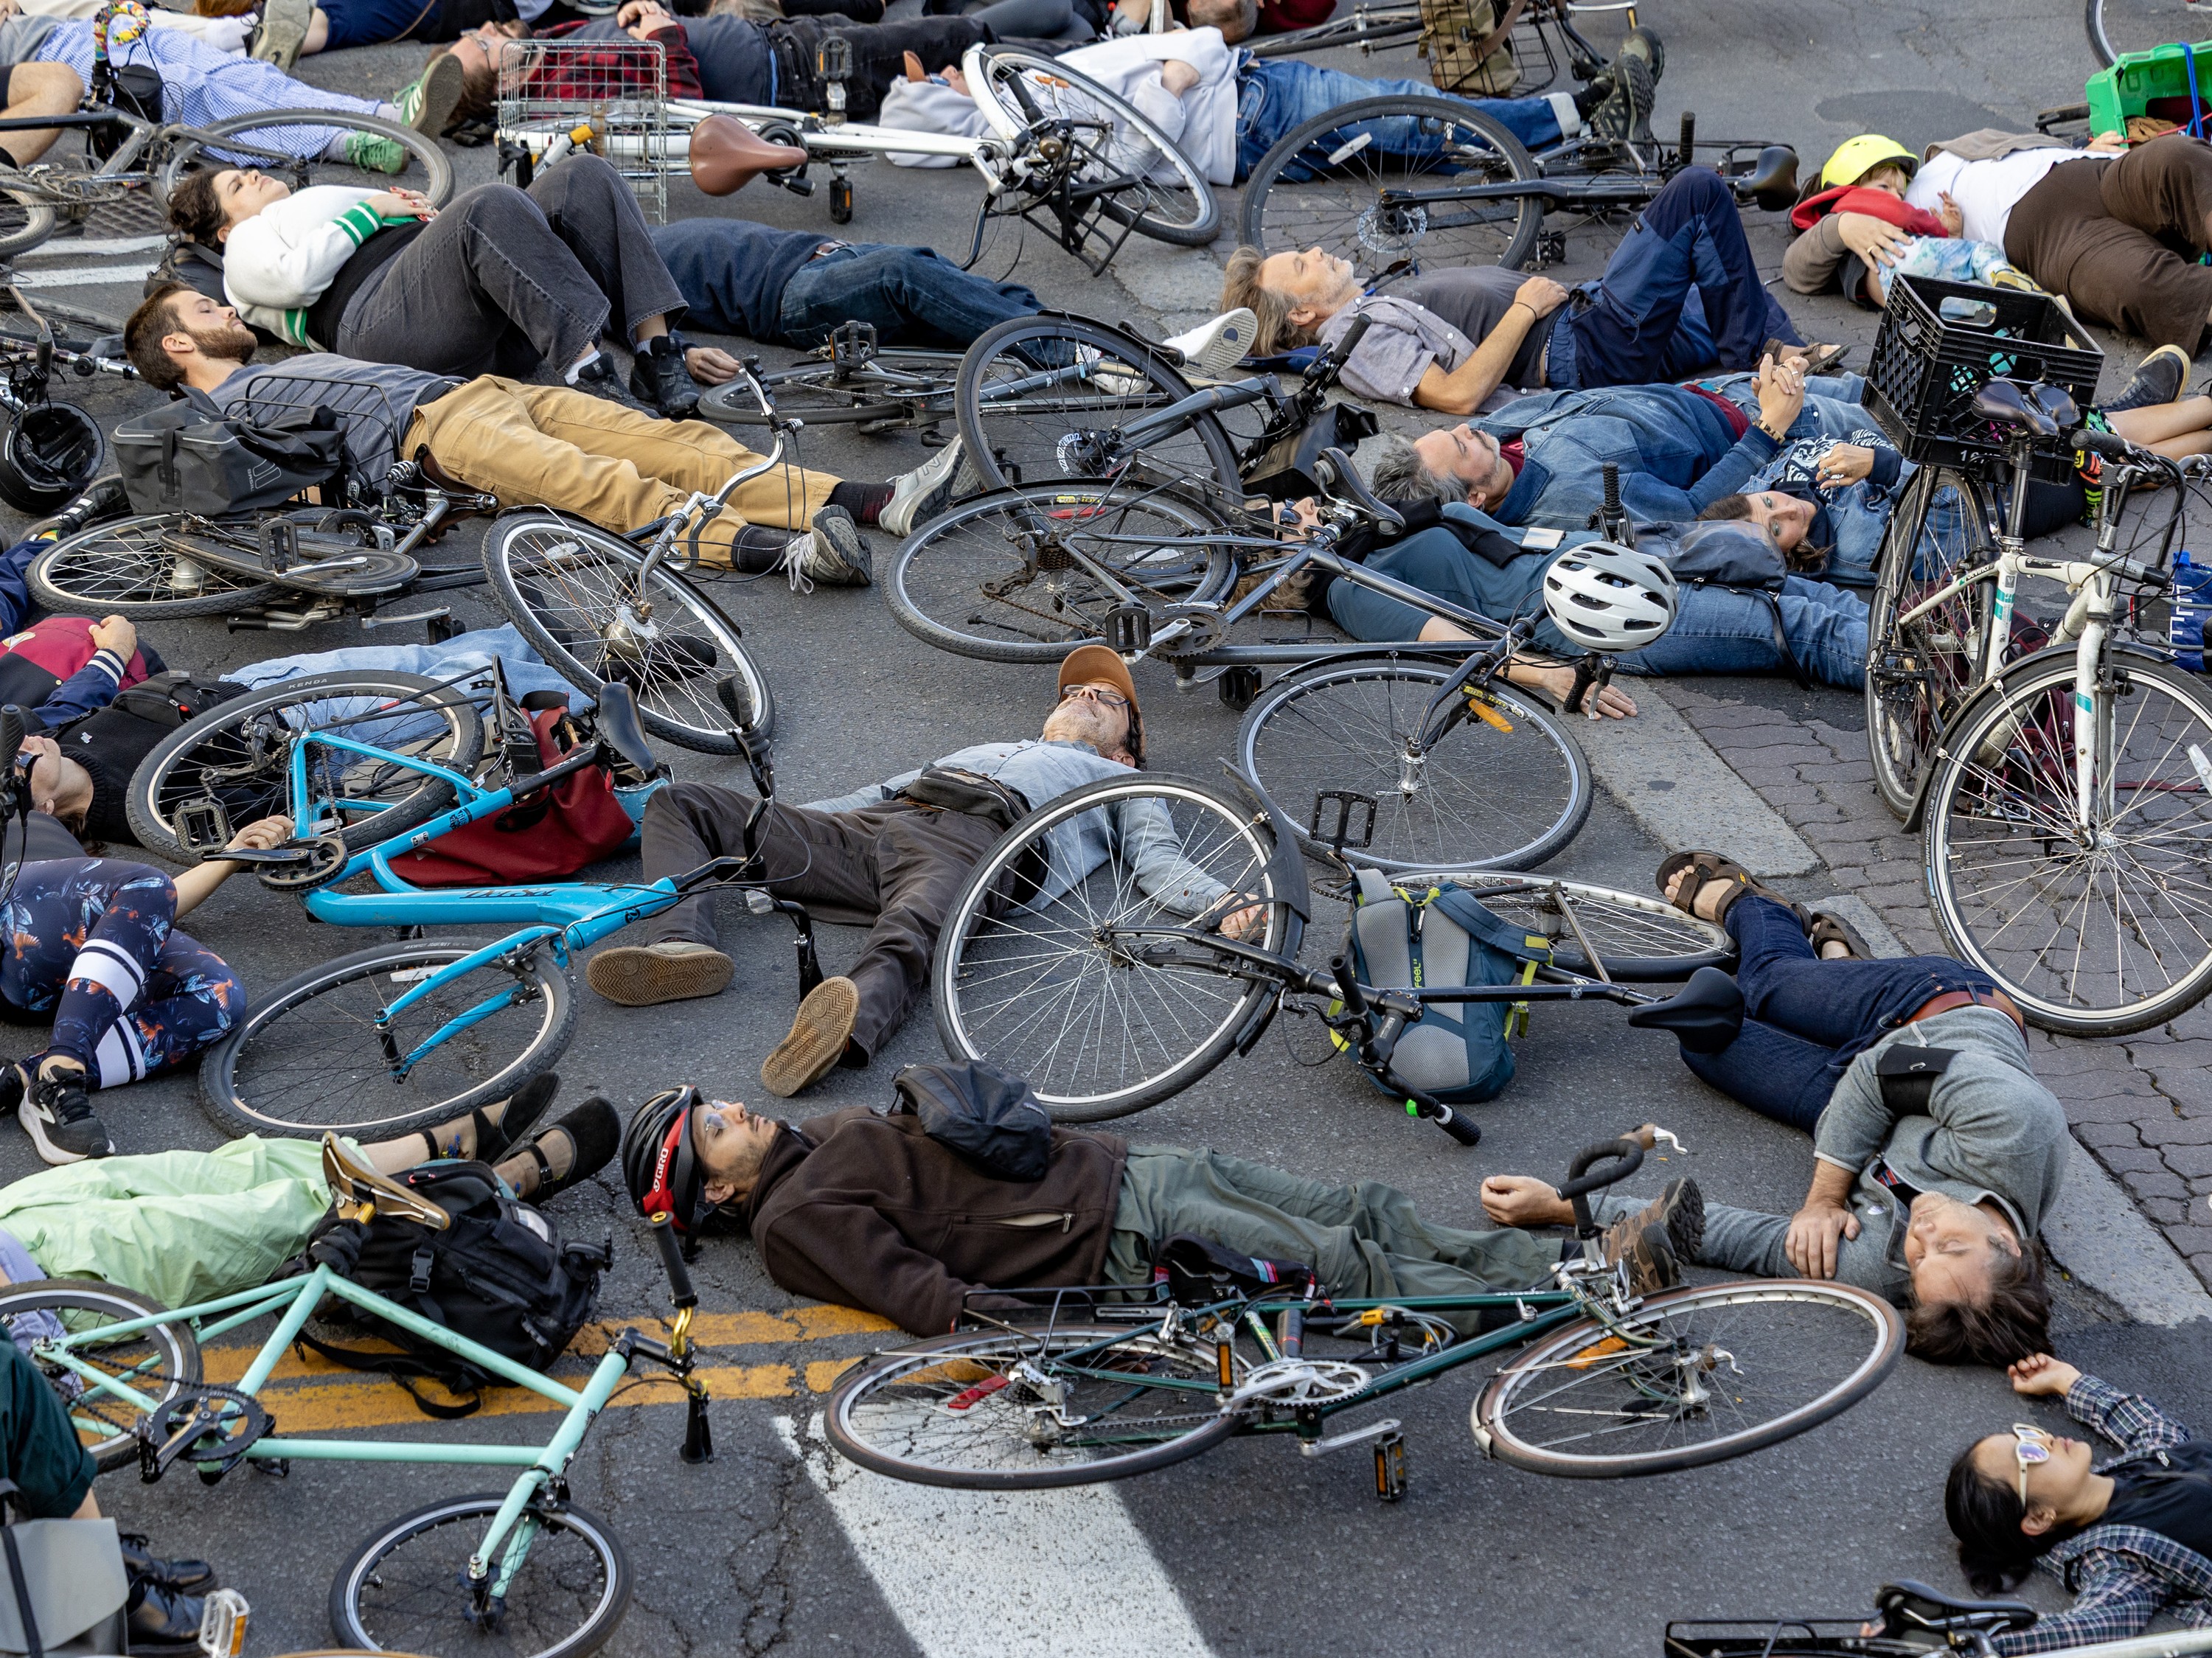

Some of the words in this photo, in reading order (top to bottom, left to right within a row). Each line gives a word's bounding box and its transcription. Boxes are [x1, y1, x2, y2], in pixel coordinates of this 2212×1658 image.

[288, 678, 327, 689] KENDA
[1484, 877, 1501, 886] CR18
[655, 1147, 669, 1180] GIRO
